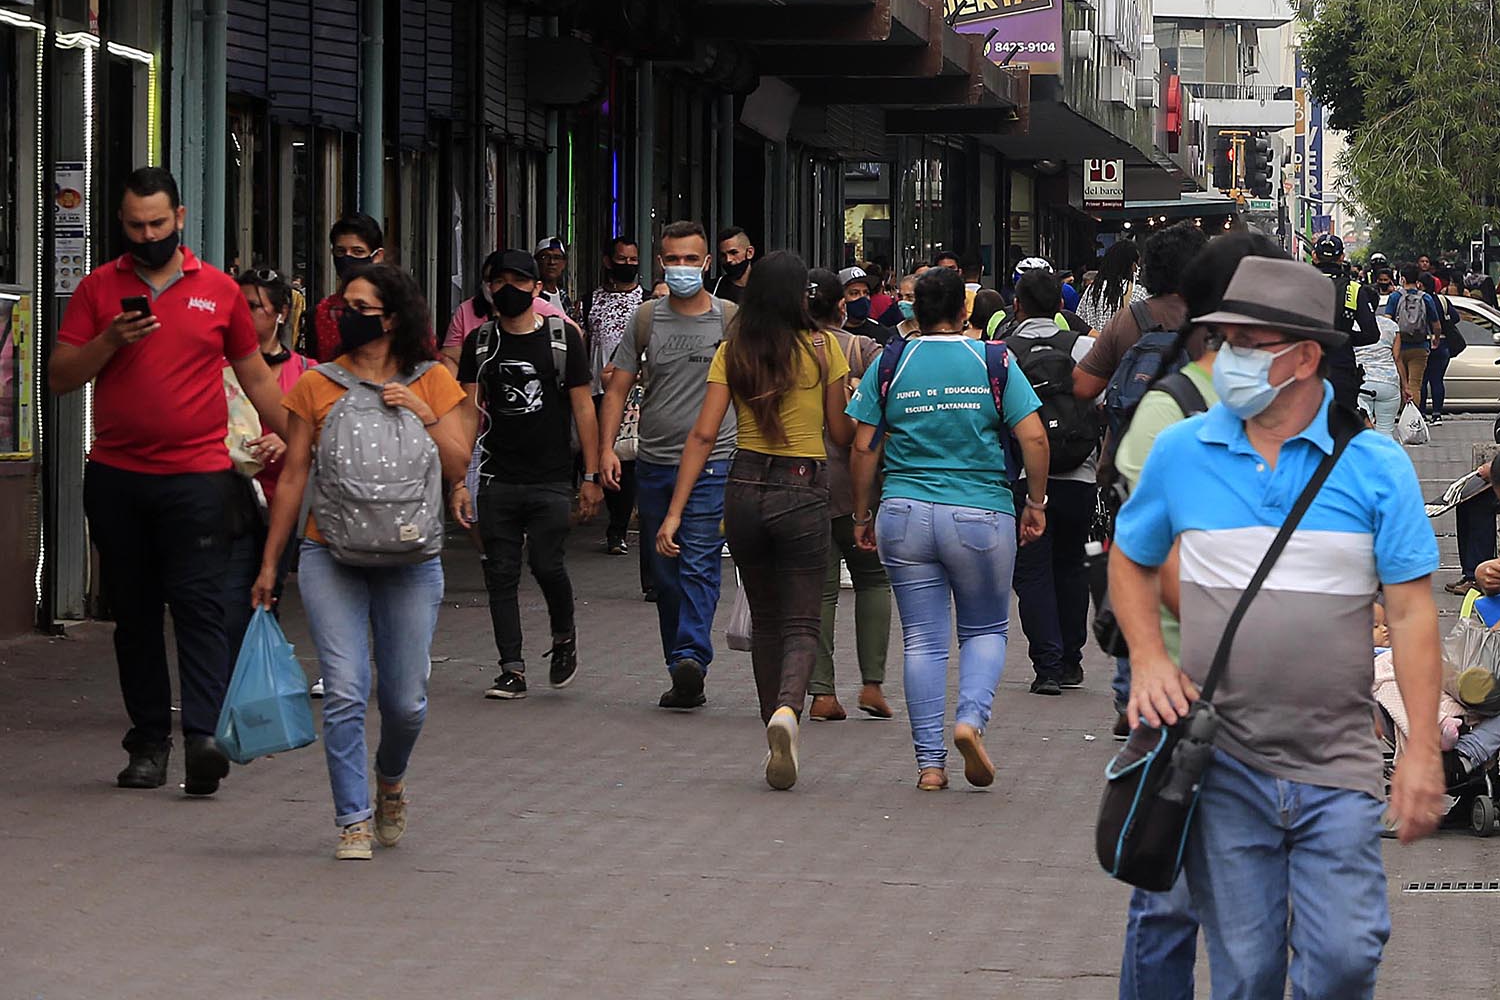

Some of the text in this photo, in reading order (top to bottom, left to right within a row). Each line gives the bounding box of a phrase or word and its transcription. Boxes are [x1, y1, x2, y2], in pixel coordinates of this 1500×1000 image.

[1084, 186, 1124, 196] del barco
[896, 385, 991, 400] JUNTA DE EDUCACIÓN
[905, 405, 935, 414] ESCUELA
